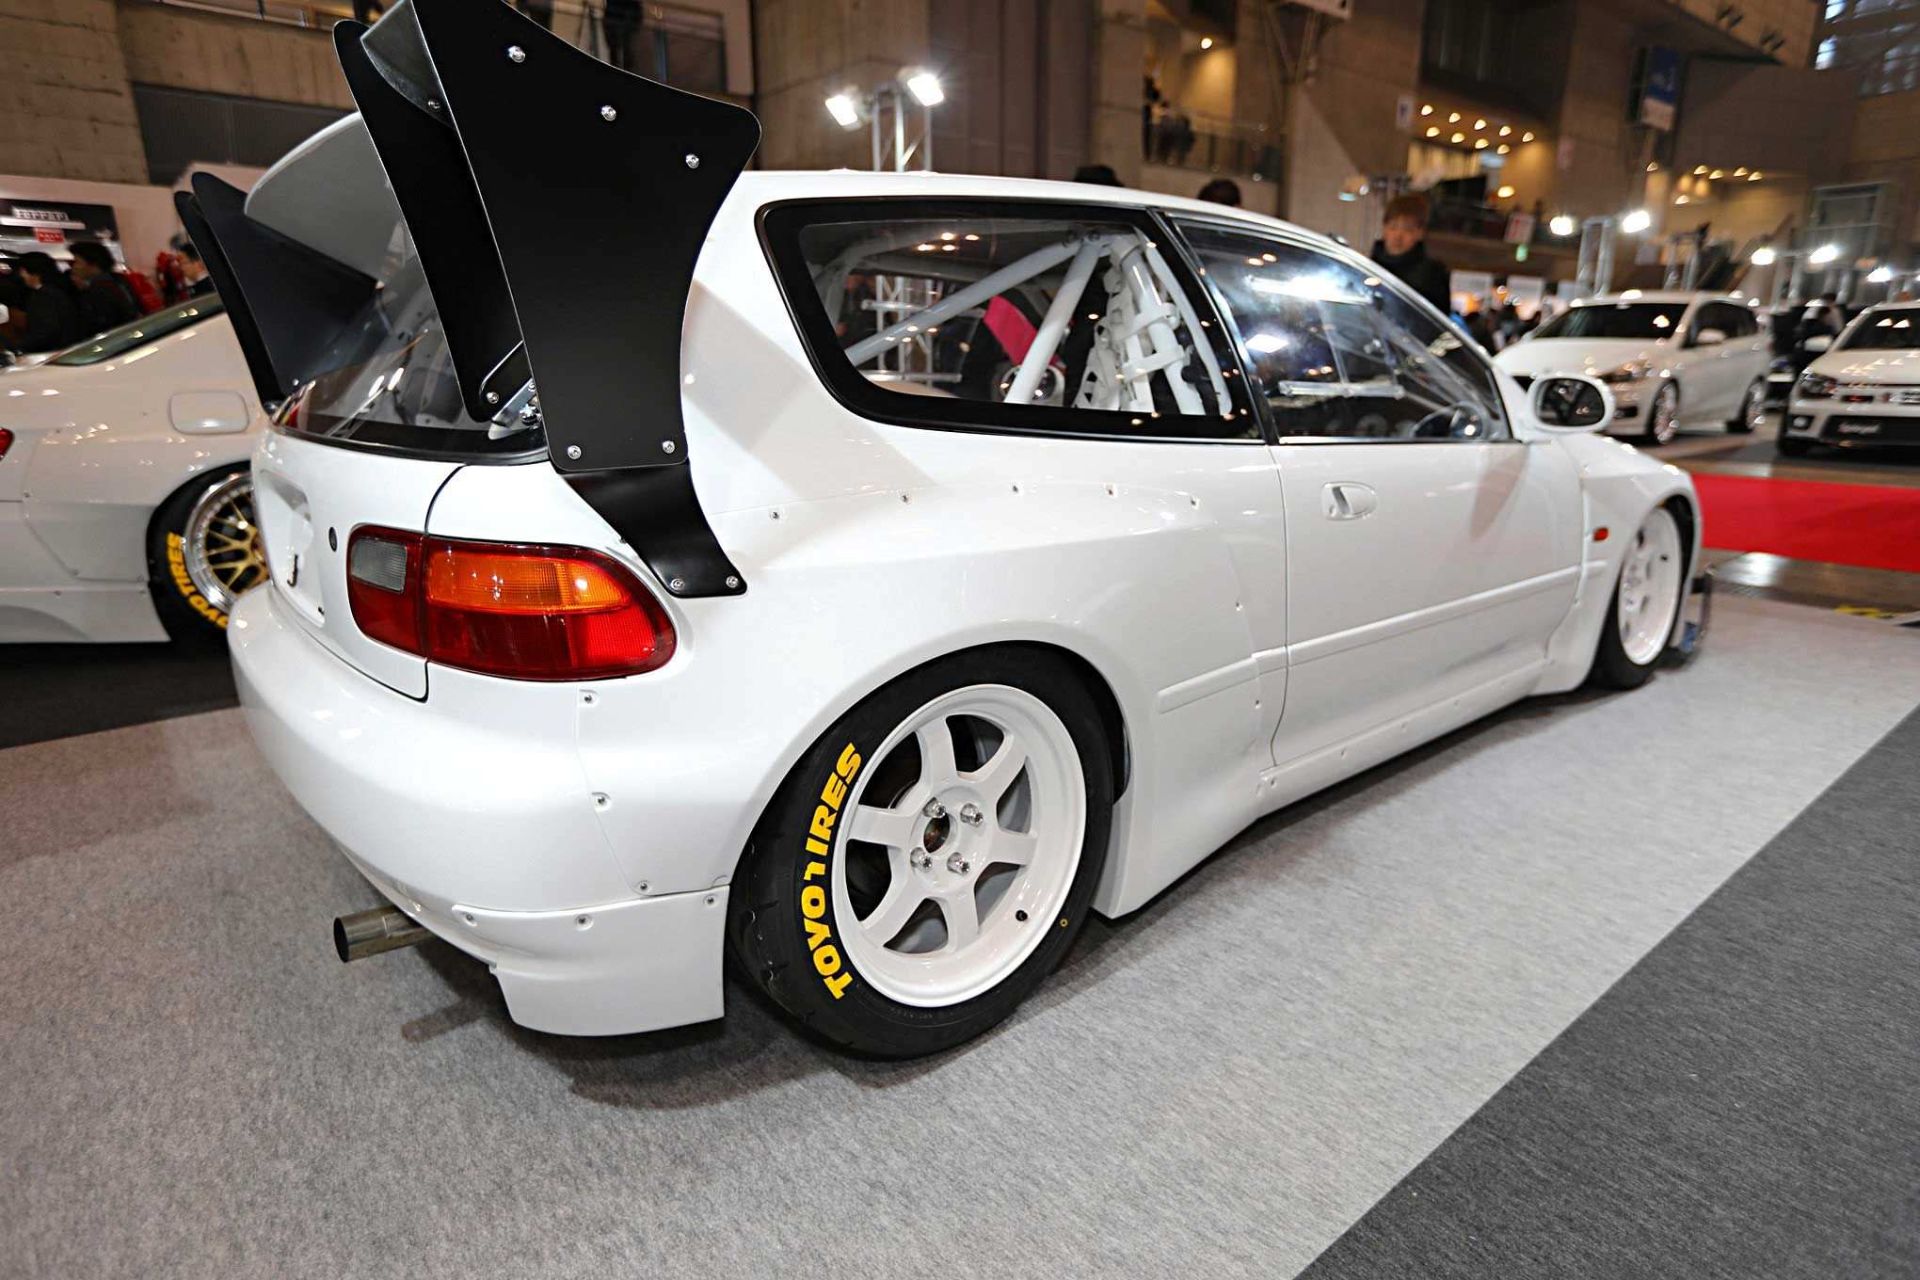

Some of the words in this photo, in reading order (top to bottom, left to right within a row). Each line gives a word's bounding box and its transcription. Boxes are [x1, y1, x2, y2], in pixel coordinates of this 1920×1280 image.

[189, 594, 229, 630] OYO
[804, 742, 862, 881] TIRES
[801, 885, 853, 1000] TOYO
